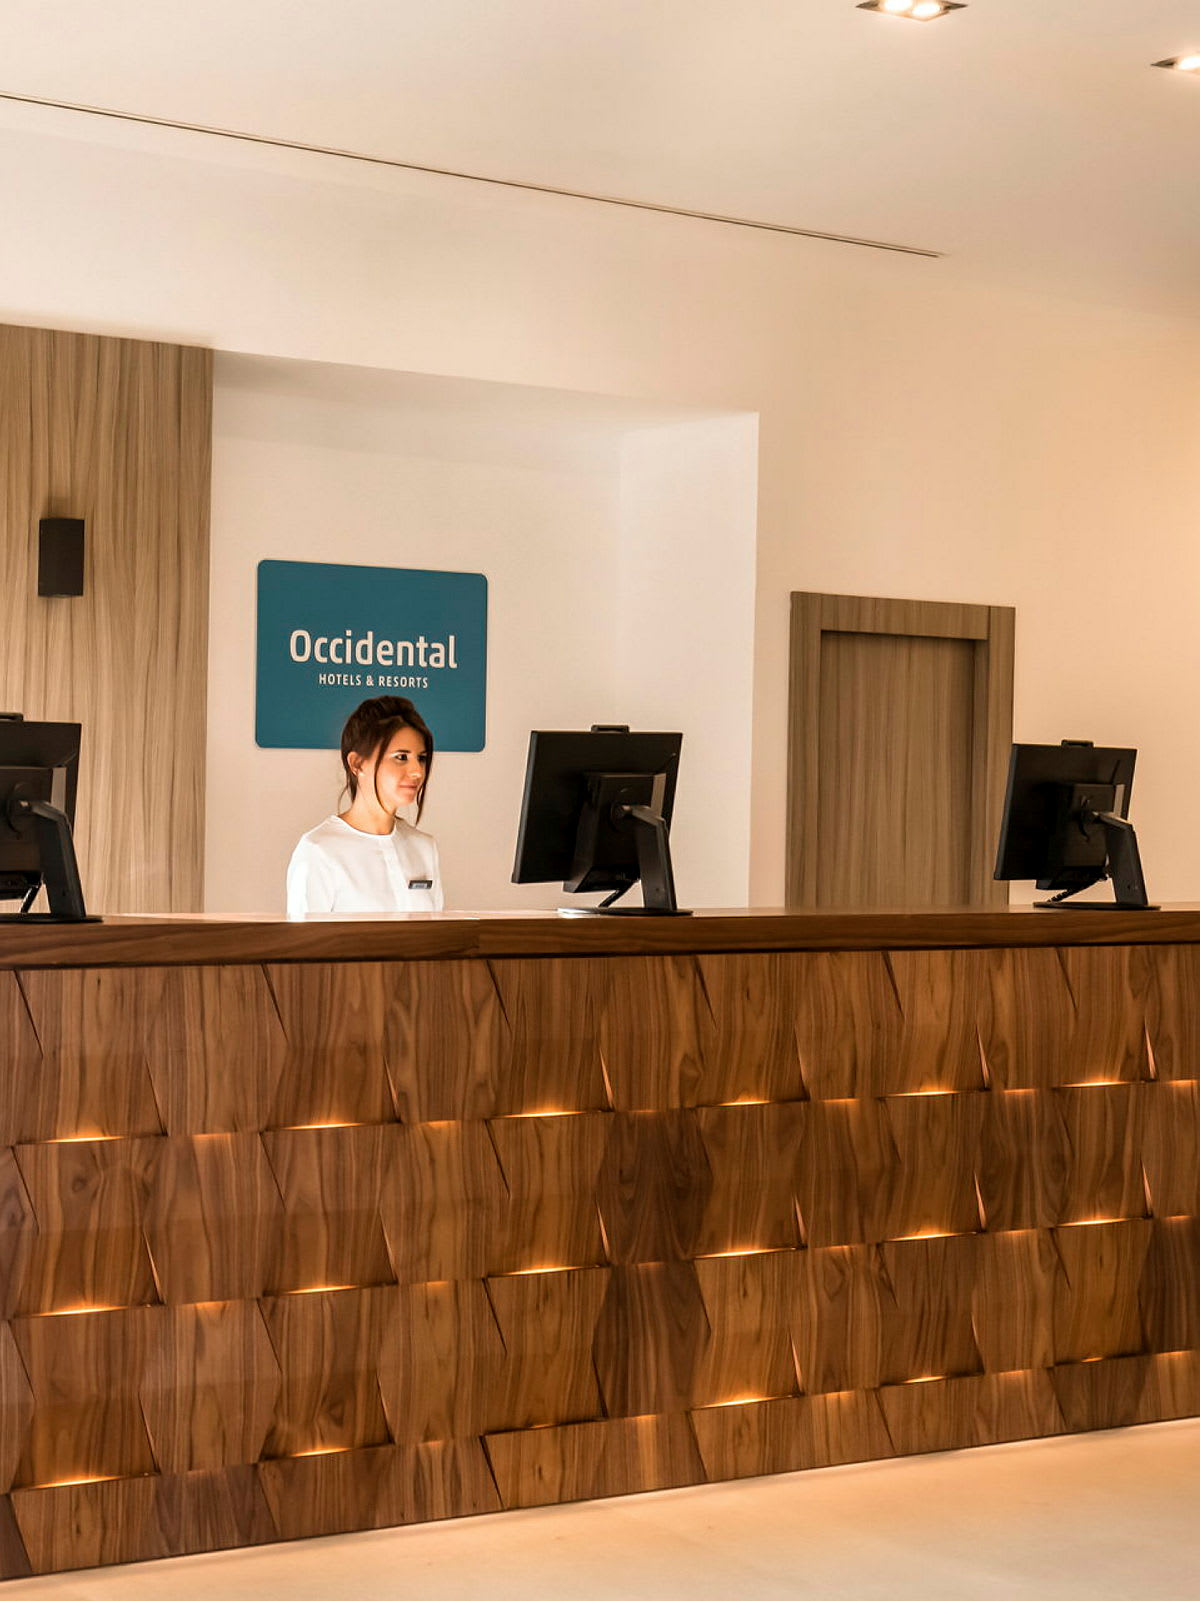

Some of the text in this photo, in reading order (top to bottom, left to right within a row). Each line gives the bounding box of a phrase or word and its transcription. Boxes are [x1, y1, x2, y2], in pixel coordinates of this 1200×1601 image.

[290, 629, 458, 669] Occidental
[319, 673, 428, 688] HOTELS & RESORTS
